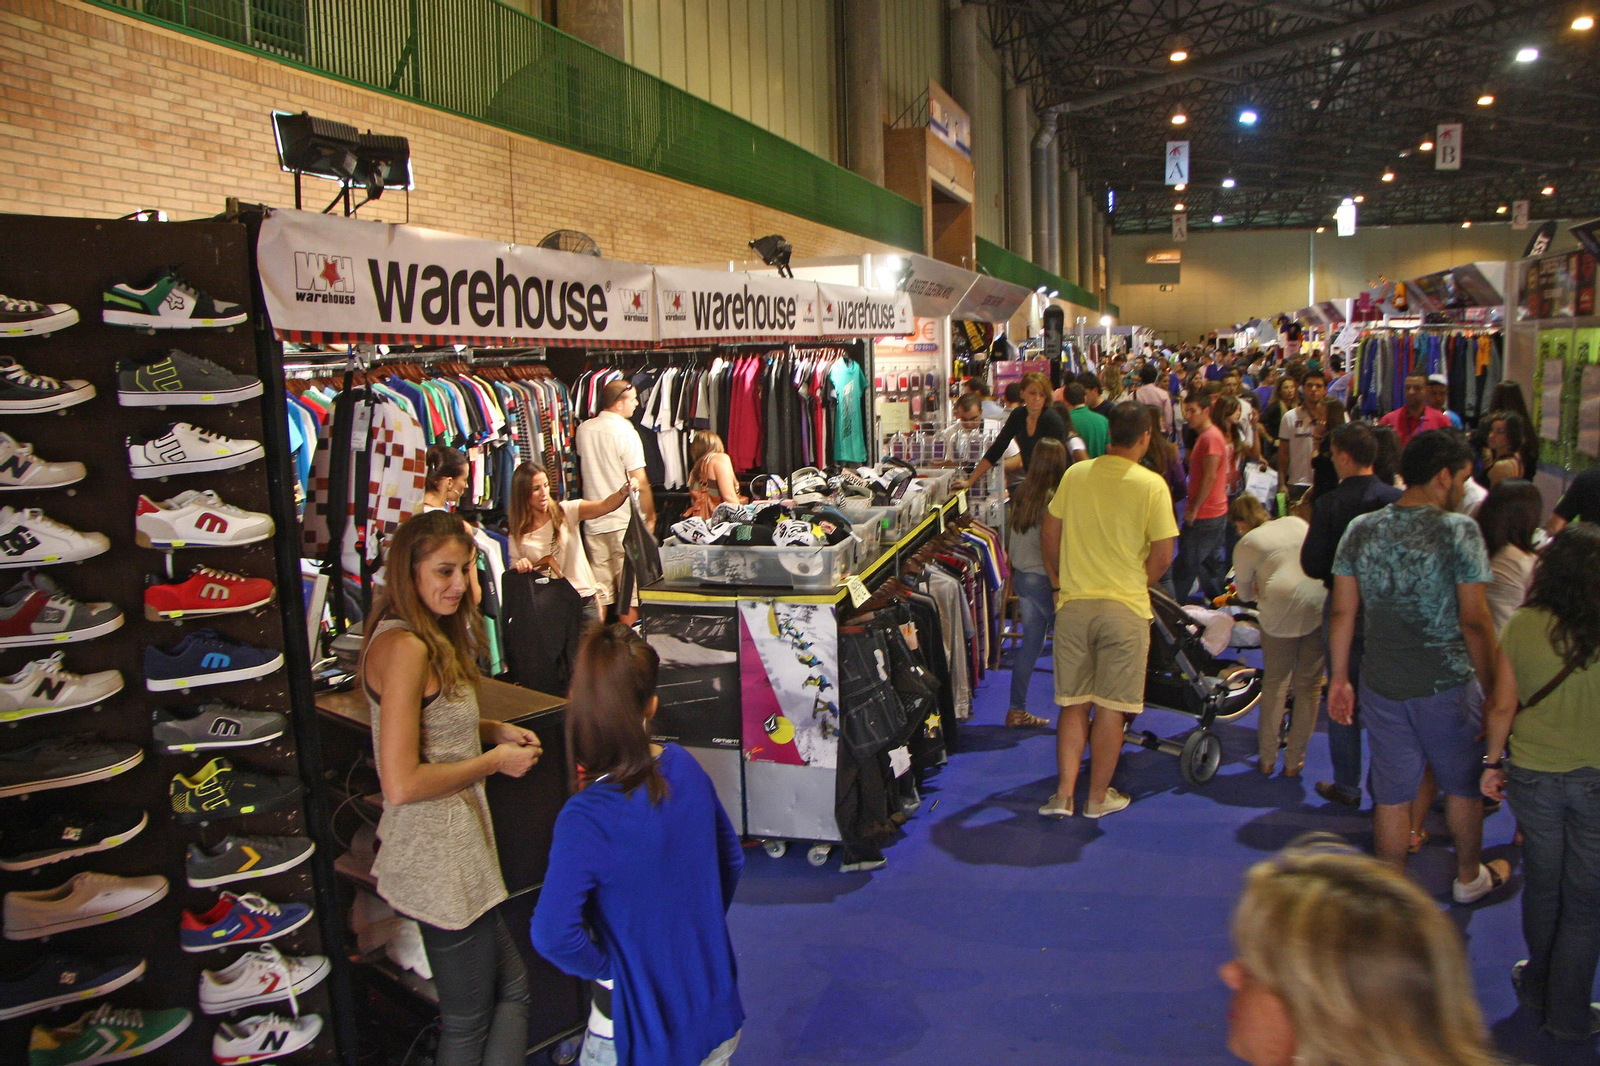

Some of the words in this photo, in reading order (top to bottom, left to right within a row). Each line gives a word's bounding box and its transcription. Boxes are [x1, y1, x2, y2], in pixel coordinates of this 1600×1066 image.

[1441, 146, 1455, 164] B
[1168, 162, 1183, 179] A
[296, 291, 355, 305] warehouse
[367, 257, 609, 332] warehouse
[692, 283, 796, 331] warehouse
[837, 295, 895, 330] warehouse
[32, 677, 66, 701] N
[258, 1030, 290, 1051] N
